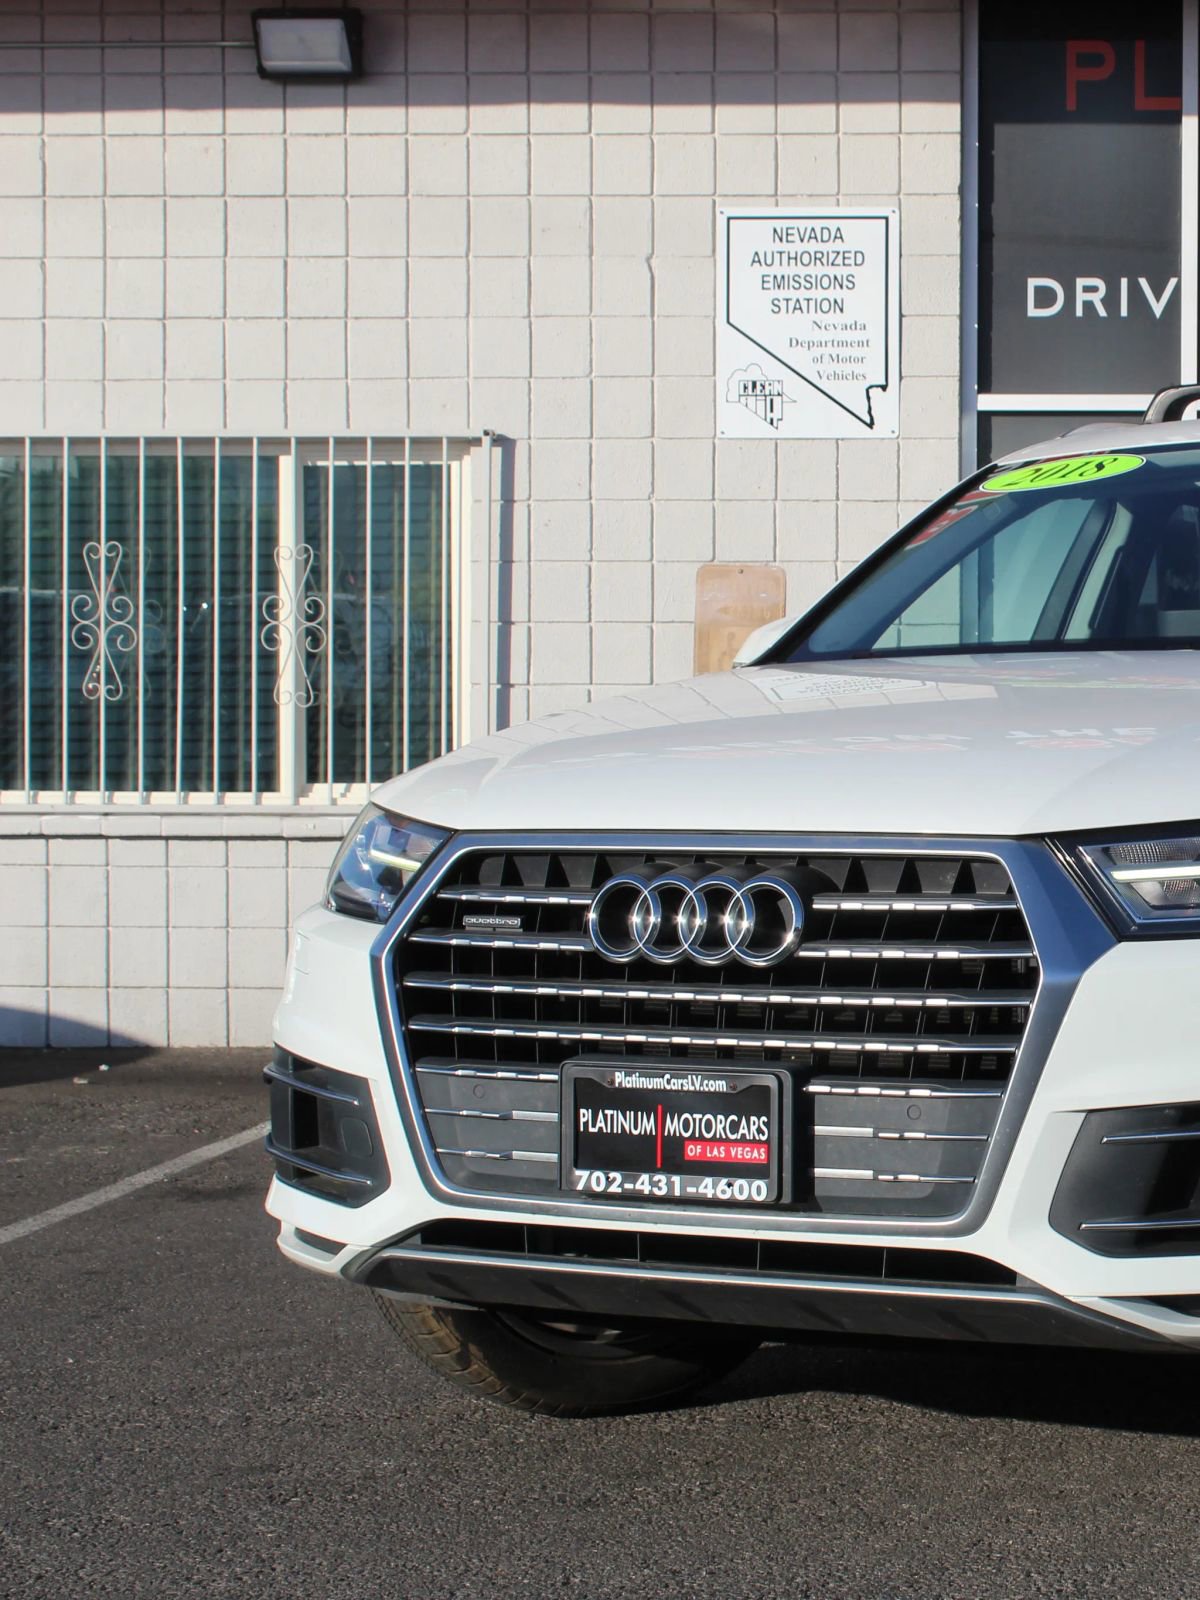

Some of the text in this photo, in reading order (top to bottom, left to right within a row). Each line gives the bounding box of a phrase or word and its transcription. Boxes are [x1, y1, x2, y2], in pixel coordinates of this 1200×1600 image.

[772, 226, 845, 244] NEVADA
[750, 250, 866, 267] AUTHORIZED
[761, 274, 856, 291] EMISSIONS
[771, 298, 845, 314] STATION
[811, 320, 867, 332] Nevada
[789, 337, 870, 351] Department
[812, 353, 866, 364] of Motor
[816, 370, 867, 381] Vehicles
[1002, 457, 1118, 487] 2018
[465, 917, 518, 925] quattro
[614, 1071, 727, 1092] PlatinumCarsLV.com
[579, 1108, 769, 1142] PLATINUM MOTORCARS
[687, 1145, 766, 1160] OF LAS VEGAS
[574, 1170, 768, 1202] 702-431-4600
